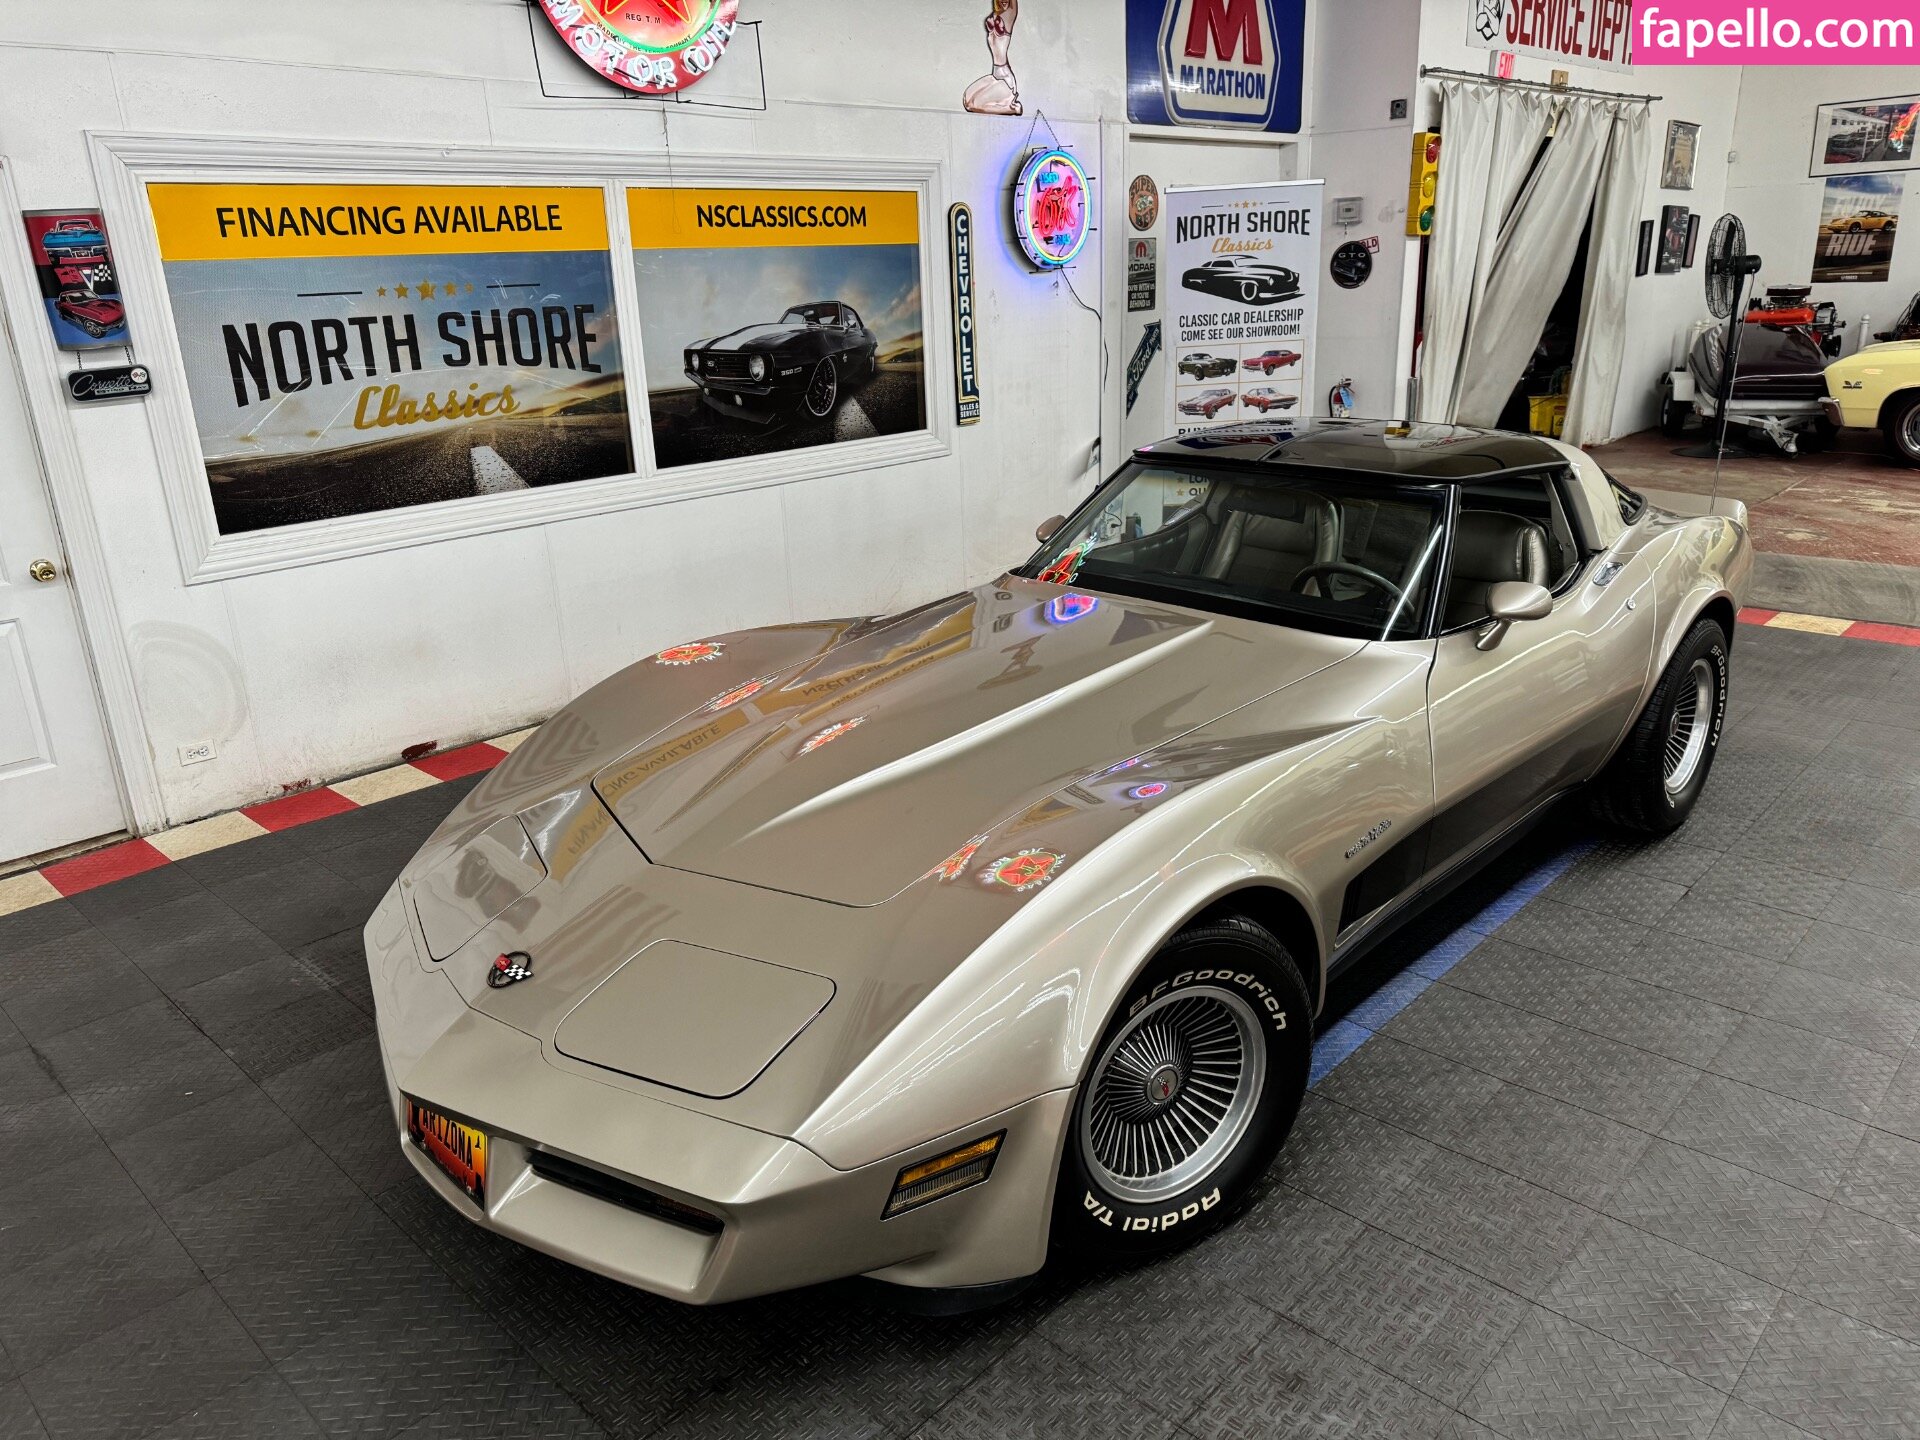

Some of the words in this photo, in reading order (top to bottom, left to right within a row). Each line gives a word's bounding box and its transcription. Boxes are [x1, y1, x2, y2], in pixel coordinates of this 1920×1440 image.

[1505, 0, 1585, 56] SERVICE
[1588, 0, 1632, 66] DEPT.
[1180, 64, 1265, 100] MARATHON
[216, 205, 405, 238] FINANCING
[413, 204, 563, 234] AVAILABLE
[696, 204, 867, 228] NSCLASSICS.COM
[1135, 207, 1155, 228] BEE
[1176, 212, 1240, 244] NORTH
[1246, 208, 1311, 236] SHORE
[1211, 237, 1274, 254] Classics
[1825, 233, 1877, 257] RIDE
[1128, 262, 1156, 272] MOPAR
[956, 214, 974, 393] CHEVROLET
[1179, 313, 1219, 329] CLASSIC
[1221, 311, 1241, 326] CAR
[1243, 308, 1304, 324] DEALERSHIP
[1181, 329, 1206, 342] COME
[1208, 328, 1224, 340] SEE
[1226, 326, 1244, 339] OUR
[1246, 324, 1300, 338] SHOWROOM!
[222, 313, 422, 407] NORTH
[437, 304, 602, 374] SHORE
[1132, 342, 1152, 382] Ford
[72, 374, 135, 397] Corvette
[353, 382, 521, 430] Classics
[960, 403, 975, 412] SALES
[1710, 644, 1727, 747] BFGoodrich
[1129, 969, 1288, 1032] BFGoodrich
[422, 1107, 474, 1172] ARIZONA
[1083, 1190, 1114, 1227] T/A
[1123, 1187, 1222, 1233] Radial
